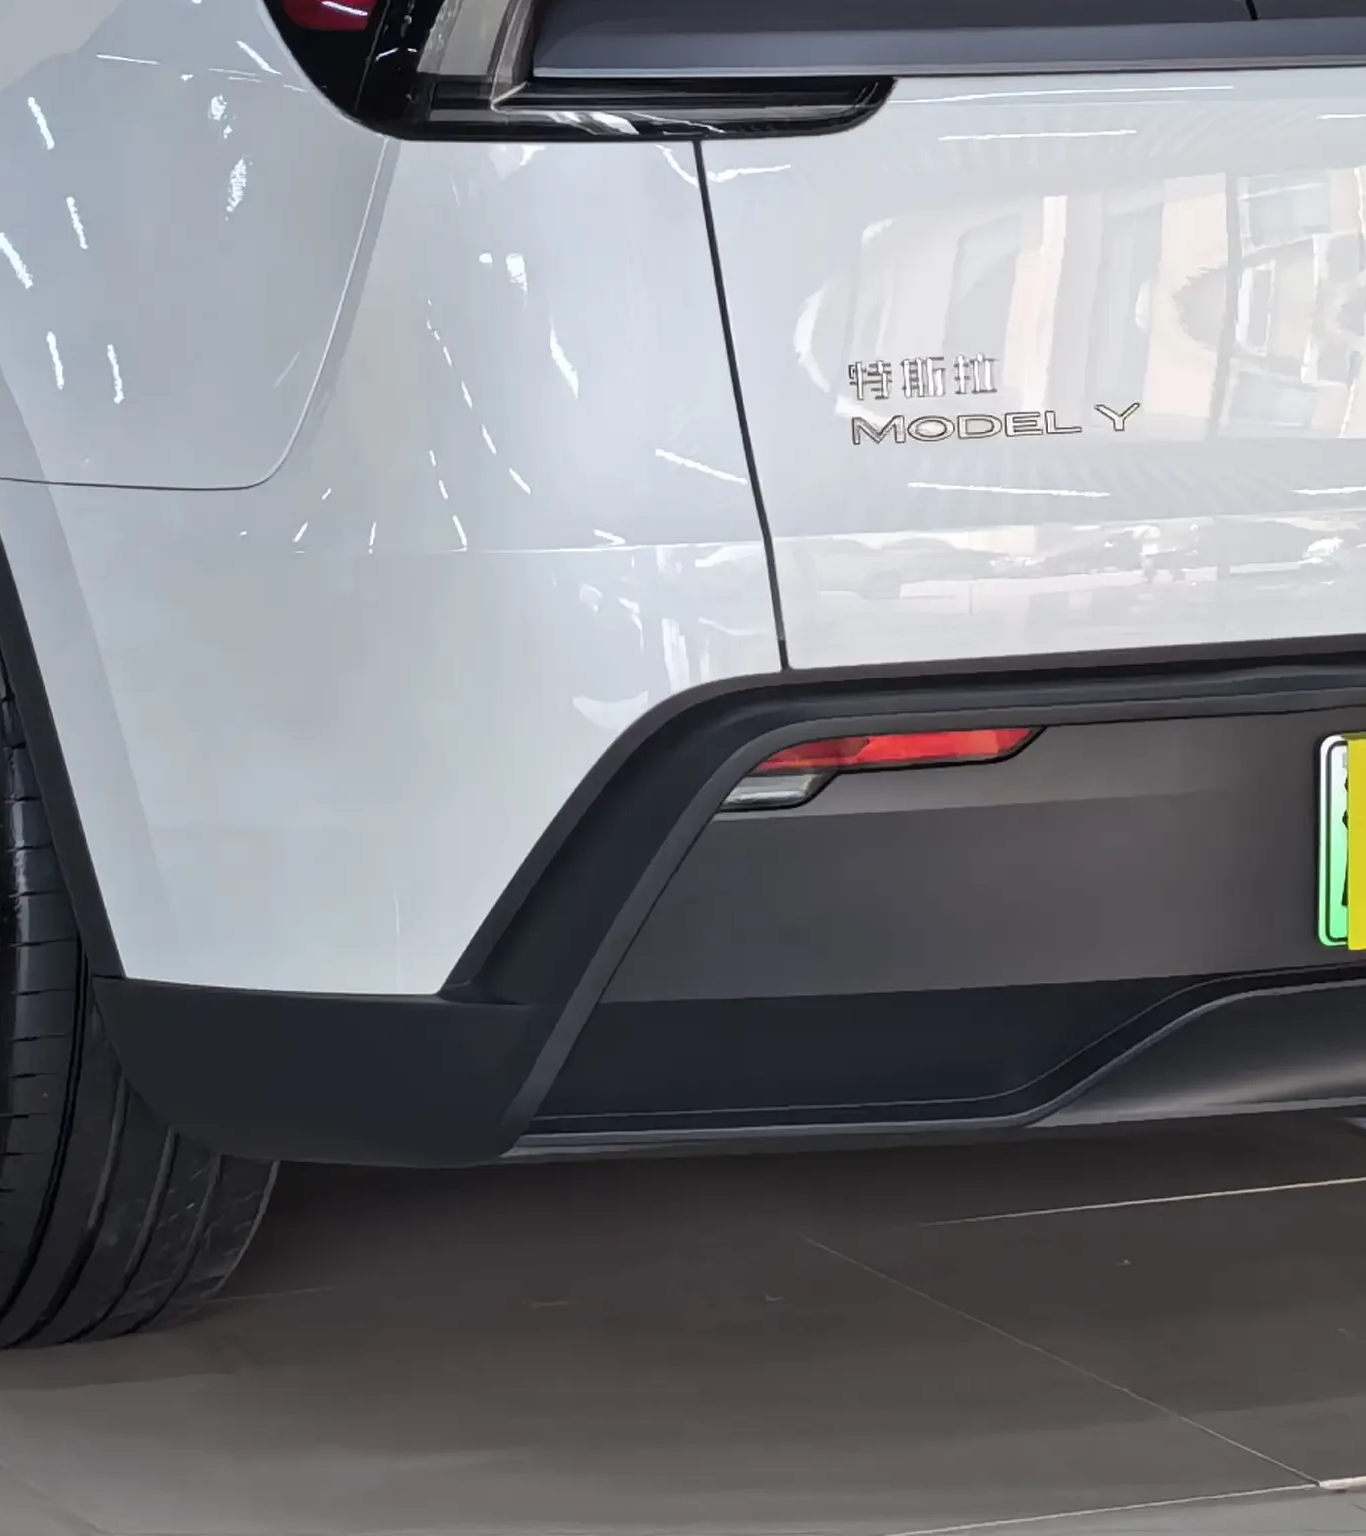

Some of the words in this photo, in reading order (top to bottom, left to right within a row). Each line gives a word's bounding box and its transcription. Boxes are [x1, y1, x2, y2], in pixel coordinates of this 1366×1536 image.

[847, 352, 1000, 401] 特斯拉
[850, 410, 1083, 446] MODEL
[1093, 402, 1142, 432] Y
